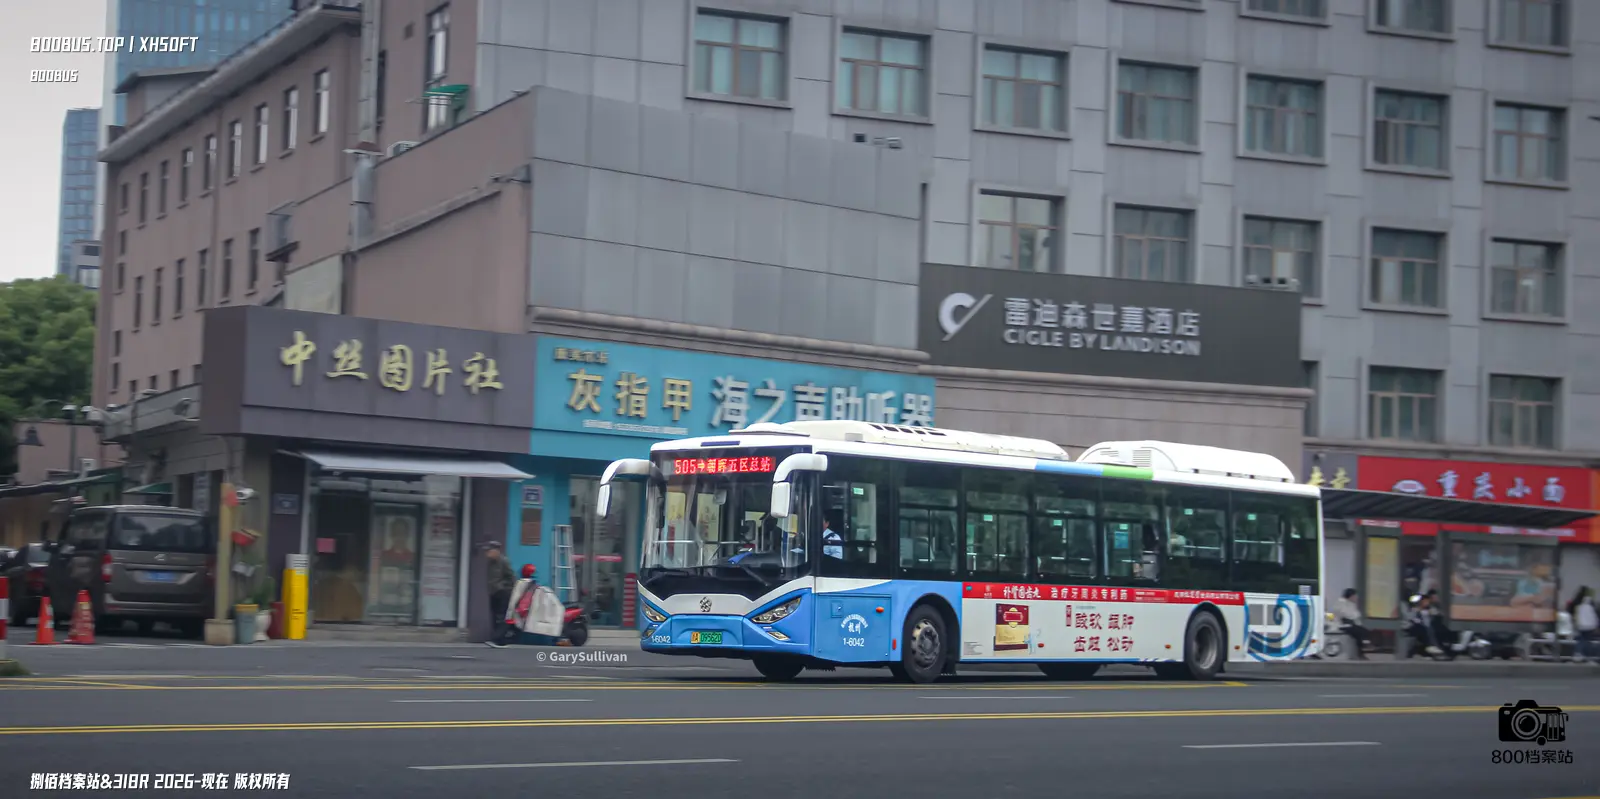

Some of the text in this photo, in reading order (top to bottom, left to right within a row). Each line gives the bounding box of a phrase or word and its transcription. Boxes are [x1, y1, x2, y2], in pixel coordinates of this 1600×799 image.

[1004, 297, 1200, 337] 雷迪森世嘉酒店
[1004, 328, 1201, 356] CIGLE BY LANDISON
[280, 330, 504, 395] 中丝图片社
[567, 368, 693, 421] 灰指甲
[674, 456, 771, 475] 505 朝晖五区总站
[1436, 470, 1566, 502] 重庆小面
[651, 635, 671, 644] 1-6042
[843, 637, 865, 647] 1-6042
